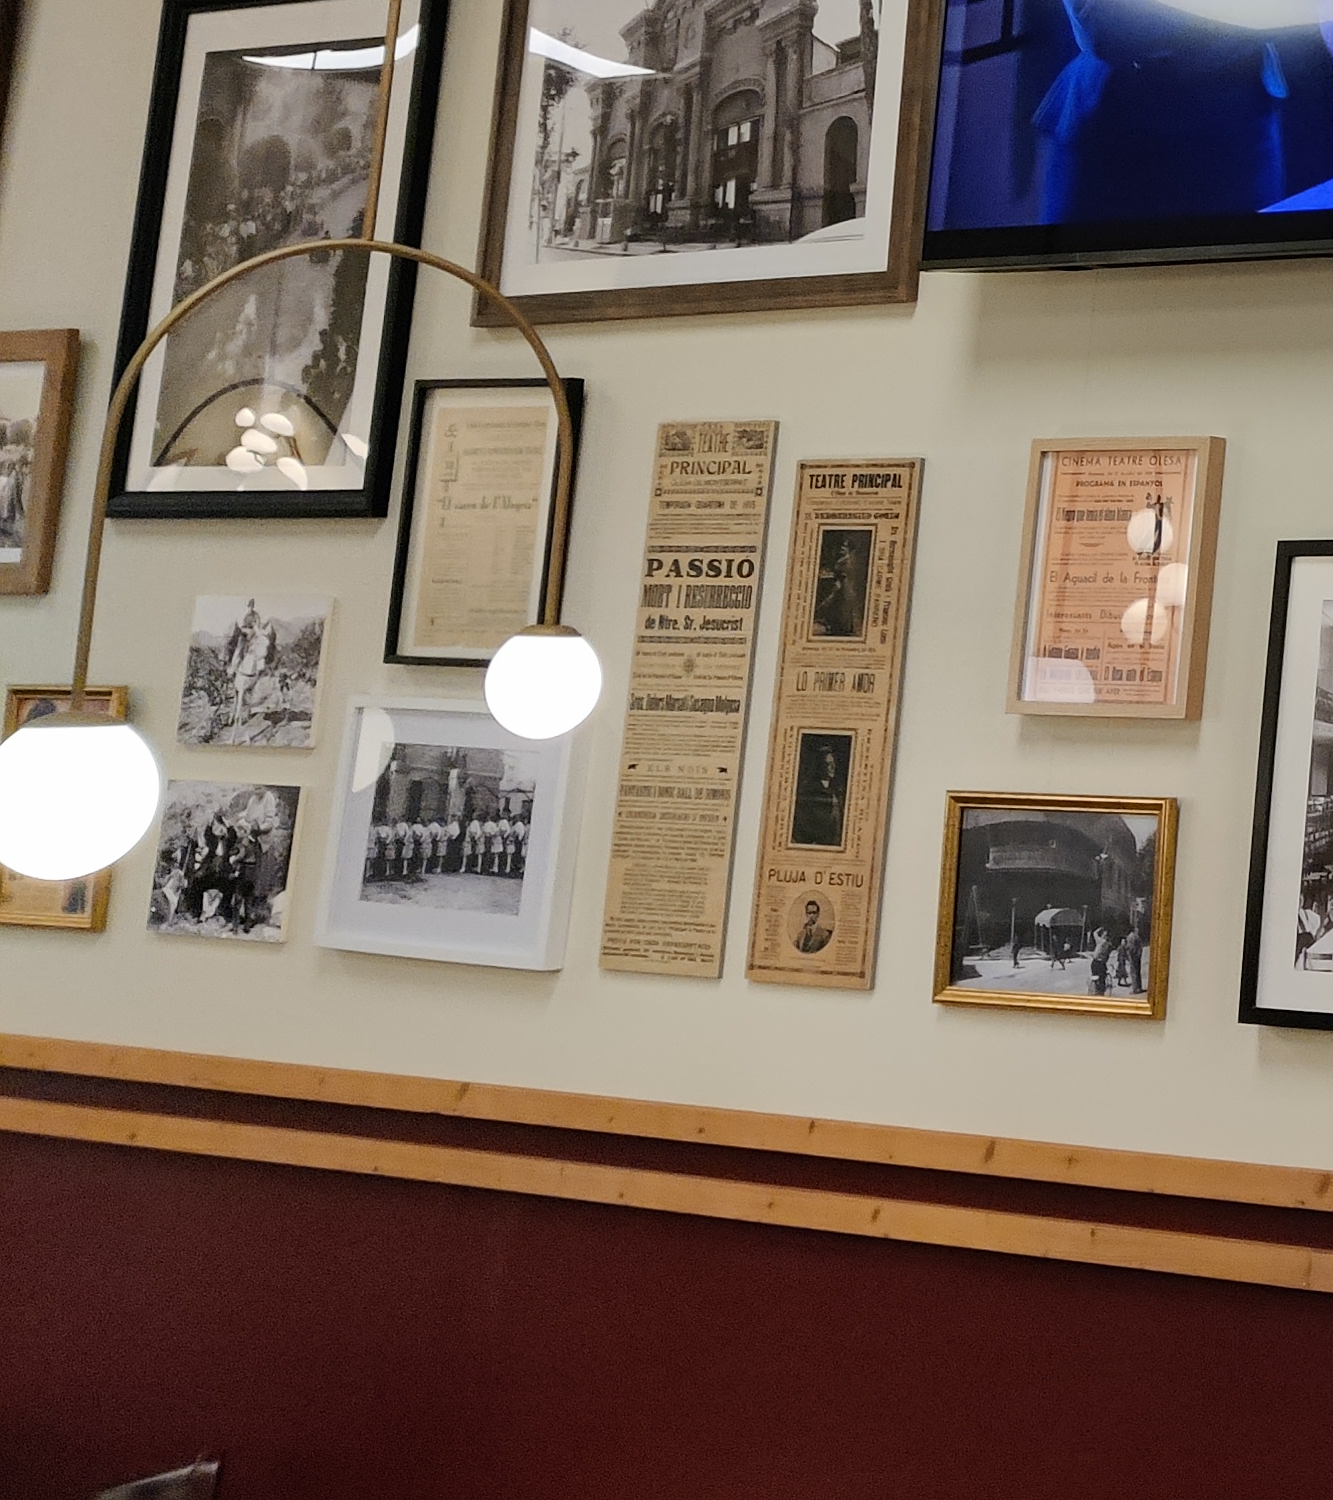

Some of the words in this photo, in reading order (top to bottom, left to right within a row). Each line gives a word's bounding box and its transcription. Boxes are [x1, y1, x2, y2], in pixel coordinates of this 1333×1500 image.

[670, 460, 752, 475] PRINCIPAL
[1061, 456, 1101, 467] CINEMA
[1108, 455, 1143, 466] TEATRE
[1149, 455, 1182, 467] OLESA
[809, 474, 847, 489] TEATRE
[851, 473, 903, 489] PRINCIPAL
[645, 556, 754, 578] PASSIÓ
[1103, 572, 1114, 583] de
[1120, 572, 1127, 583] la
[699, 615, 743, 631] Jesucrist
[796, 671, 807, 692] LO
[813, 672, 846, 692] PRIMER
[768, 869, 806, 884] PLUJA
[815, 871, 864, 888] D'ESTIU
